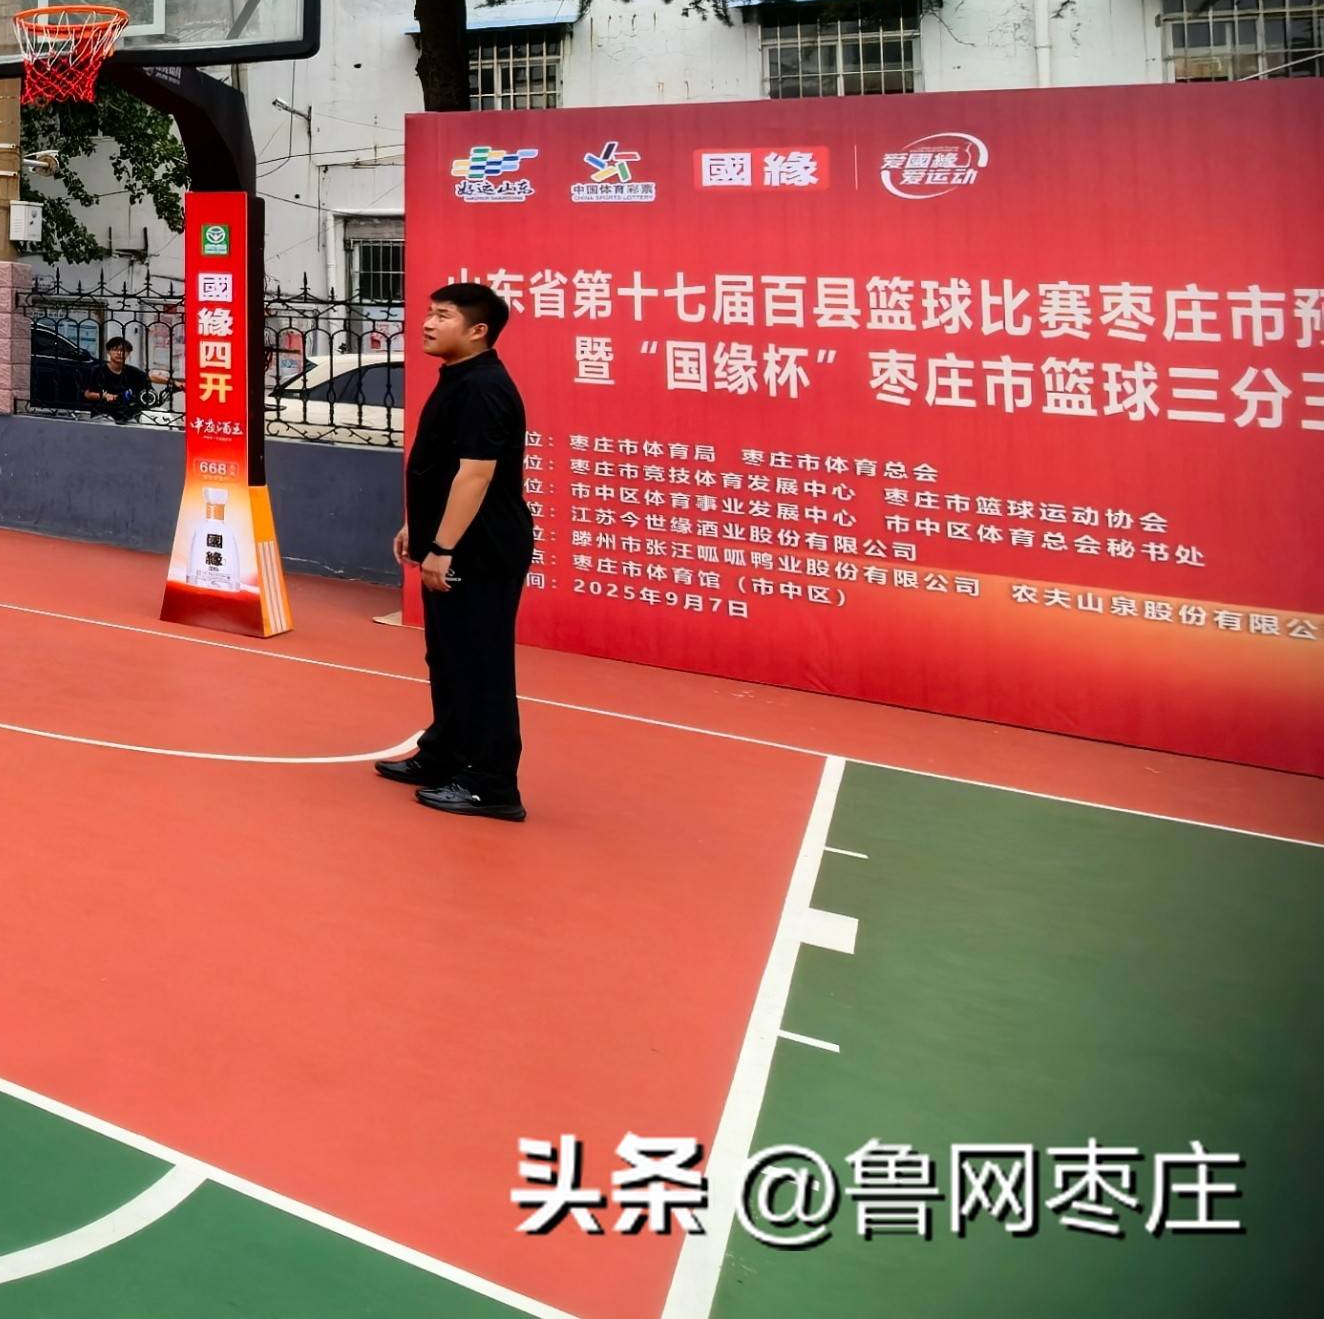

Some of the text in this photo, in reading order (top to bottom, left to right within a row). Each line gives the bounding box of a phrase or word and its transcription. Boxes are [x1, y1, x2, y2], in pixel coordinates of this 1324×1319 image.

[701, 151, 819, 187] 國緣
[900, 168, 977, 185] 爱运动
[573, 183, 653, 195] 中国体育彩票
[199, 460, 227, 476] 668
[741, 448, 939, 483] 枣庄市体育总会
[883, 486, 1169, 534] 枣庄市篮球运动协会
[885, 513, 1206, 568] 市中区体育总会秘书处
